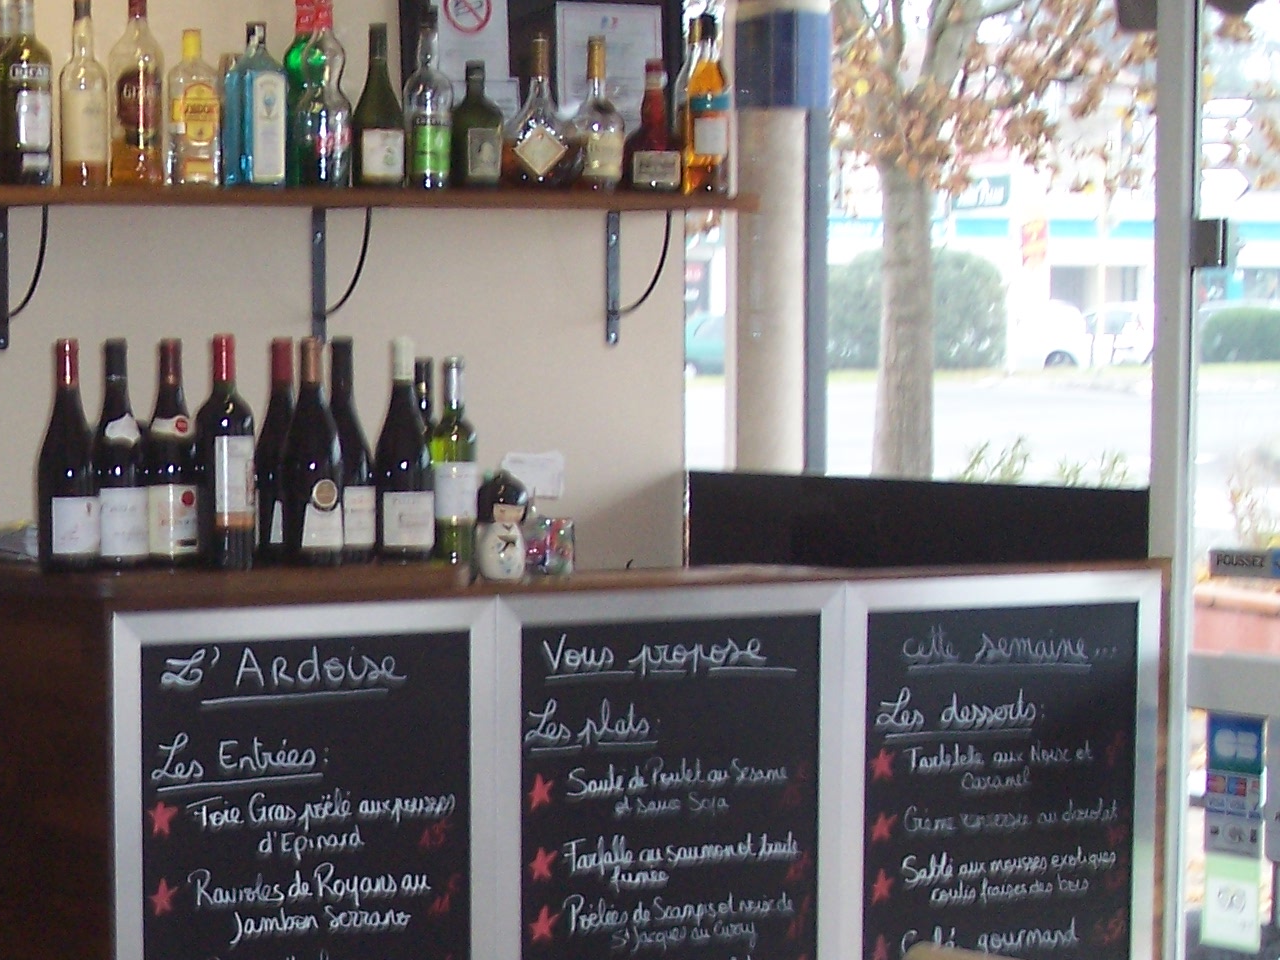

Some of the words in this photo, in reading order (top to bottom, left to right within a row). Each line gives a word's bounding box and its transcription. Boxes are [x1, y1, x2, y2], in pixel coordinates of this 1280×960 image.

[542, 633, 615, 672] Vous
[628, 637, 767, 676] propose
[972, 629, 1089, 664] semaine
[525, 698, 571, 742] Les
[875, 687, 925, 726] Les
[940, 688, 1037, 724] desserts
[151, 733, 205, 780] Les
[707, 768, 730, 783] au
[248, 792, 296, 823] Gras
[288, 870, 313, 897] de
[314, 862, 398, 906] Royans
[400, 872, 432, 890] au
[958, 862, 987, 875] aux
[229, 907, 318, 945] Jambon
[324, 906, 412, 928] Serrano
[633, 902, 651, 922] de
